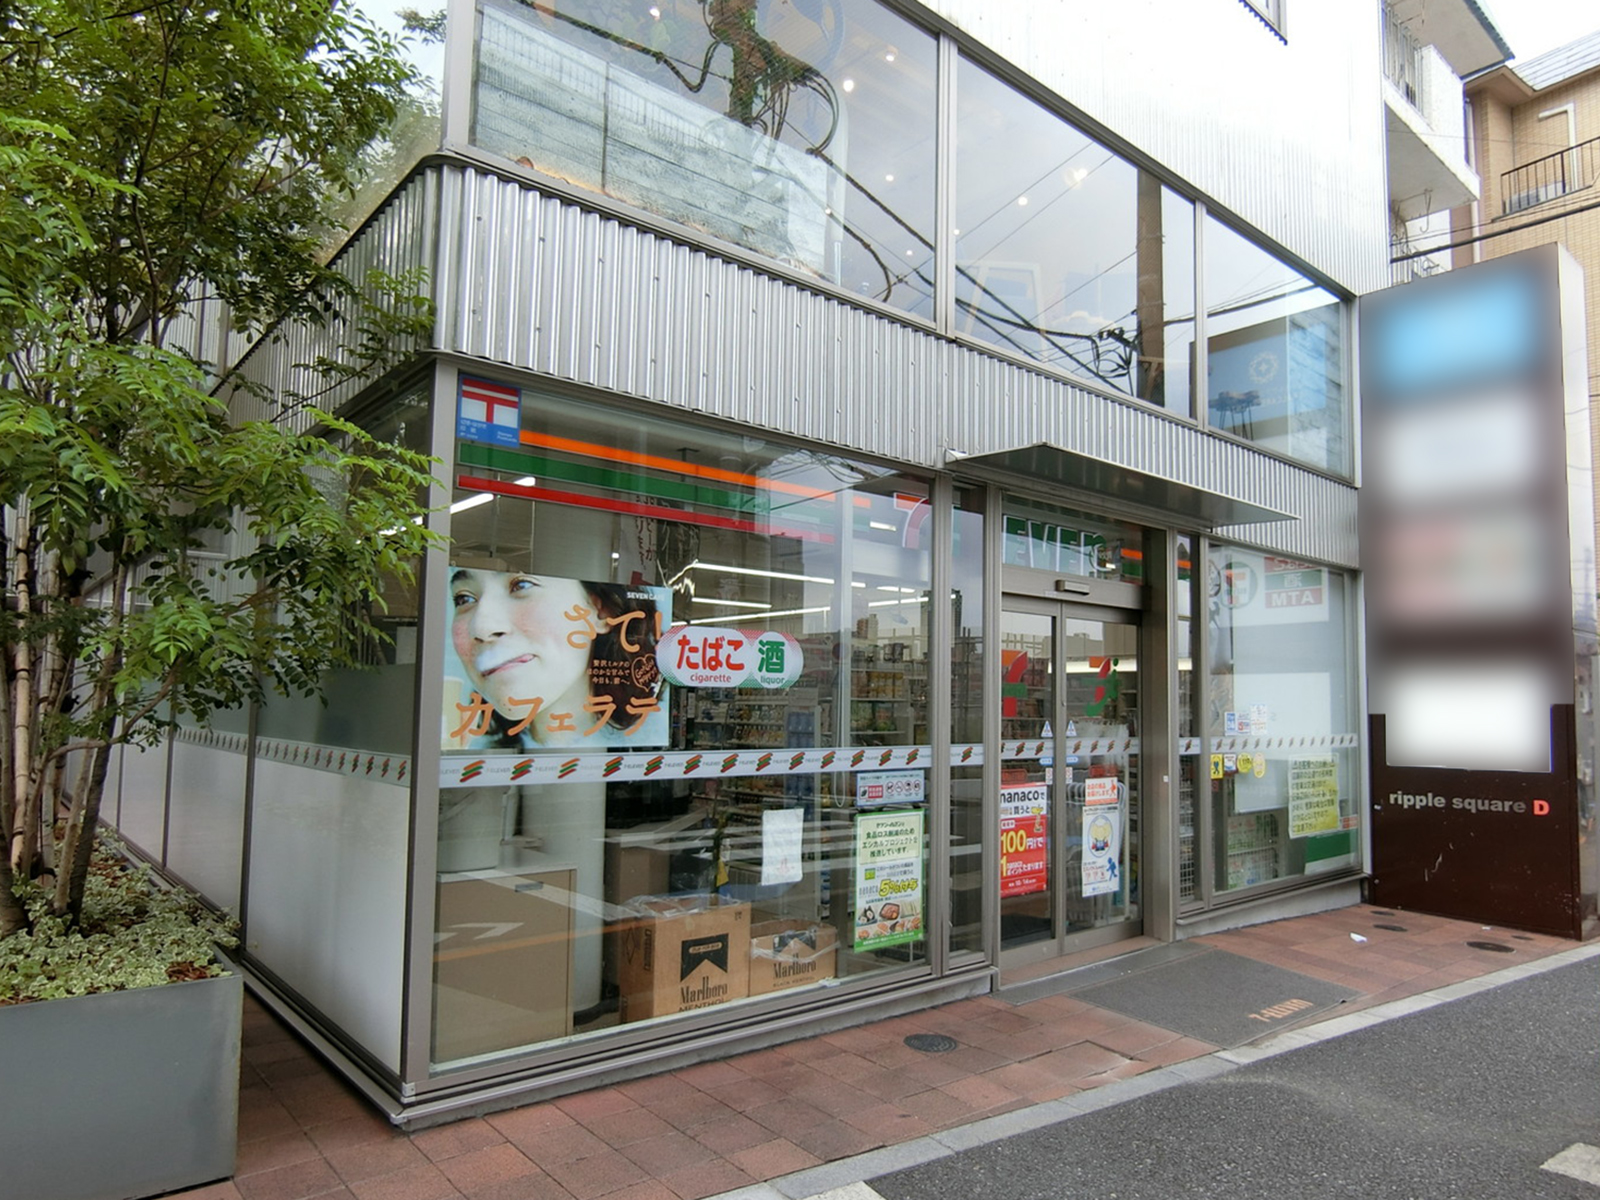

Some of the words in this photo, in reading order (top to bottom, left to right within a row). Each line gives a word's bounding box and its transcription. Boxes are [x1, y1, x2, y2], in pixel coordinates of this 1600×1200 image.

[626, 591, 648, 600] SEVEN
[676, 634, 745, 671] たばこ
[757, 639, 786, 674] 酒
[690, 673, 732, 684] cigarette
[760, 675, 786, 685] liquor
[450, 691, 662, 738] カフェラテ
[1389, 790, 1446, 810] ripple
[1452, 796, 1527, 814] square
[1533, 799, 1550, 816] D
[772, 953, 817, 979] Marlboro
[680, 975, 728, 1004] Marlboro
